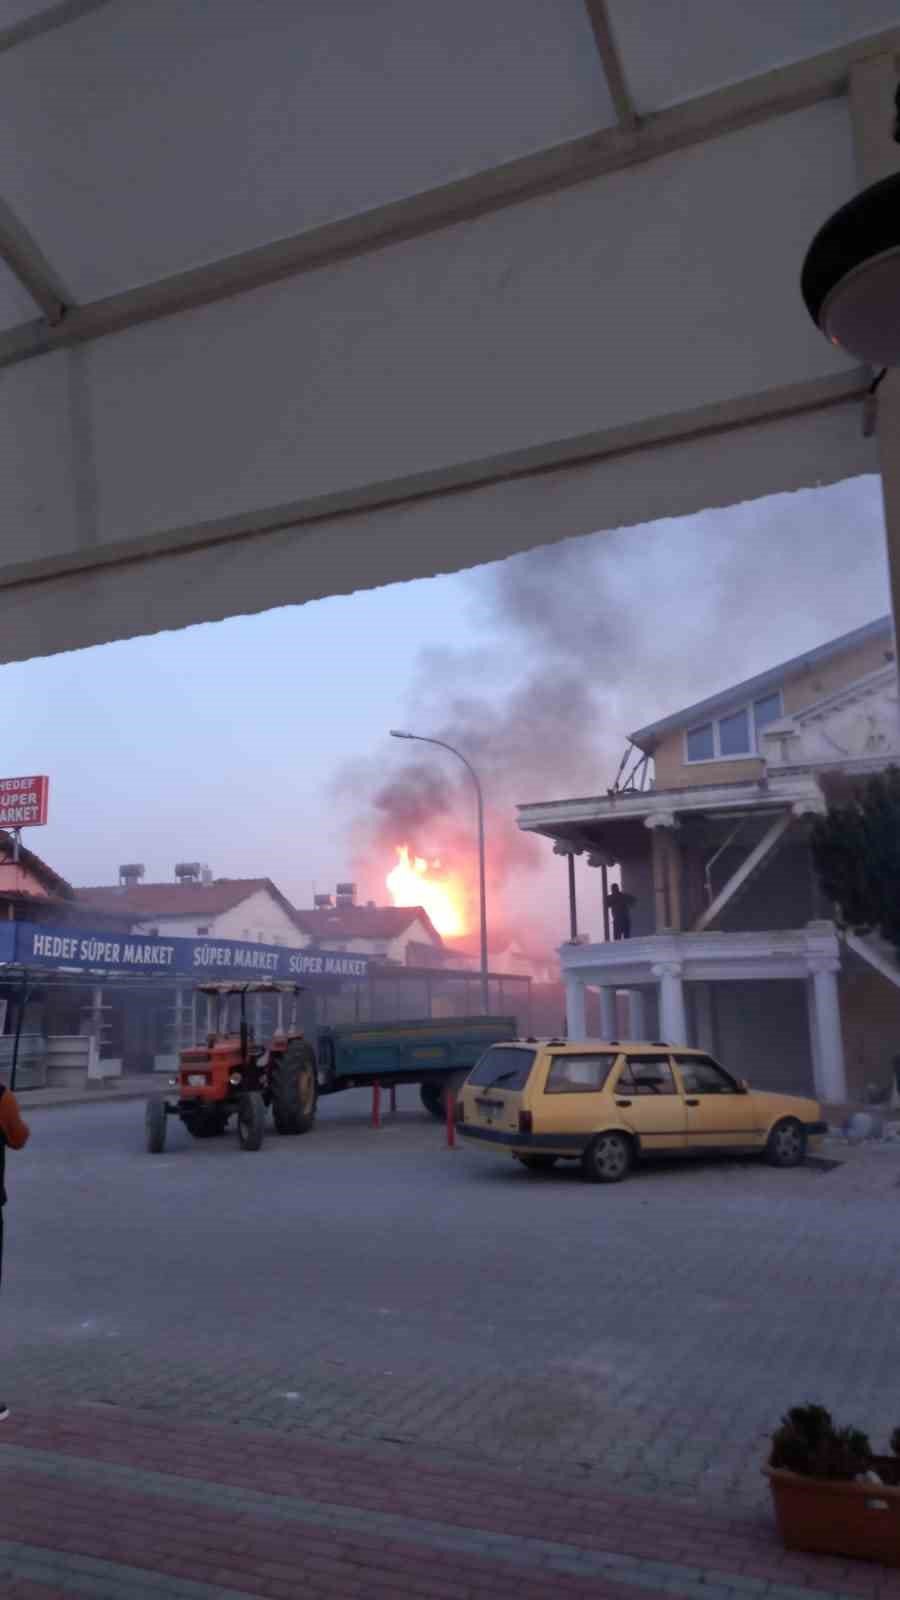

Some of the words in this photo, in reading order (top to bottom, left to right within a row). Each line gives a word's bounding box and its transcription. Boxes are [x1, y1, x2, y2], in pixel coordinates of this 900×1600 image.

[0, 806, 39, 822] ARKET
[33, 934, 78, 958] HEDEF
[122, 944, 174, 965] MARKET
[233, 949, 279, 970] MARKET
[325, 956, 367, 976] MARKET
